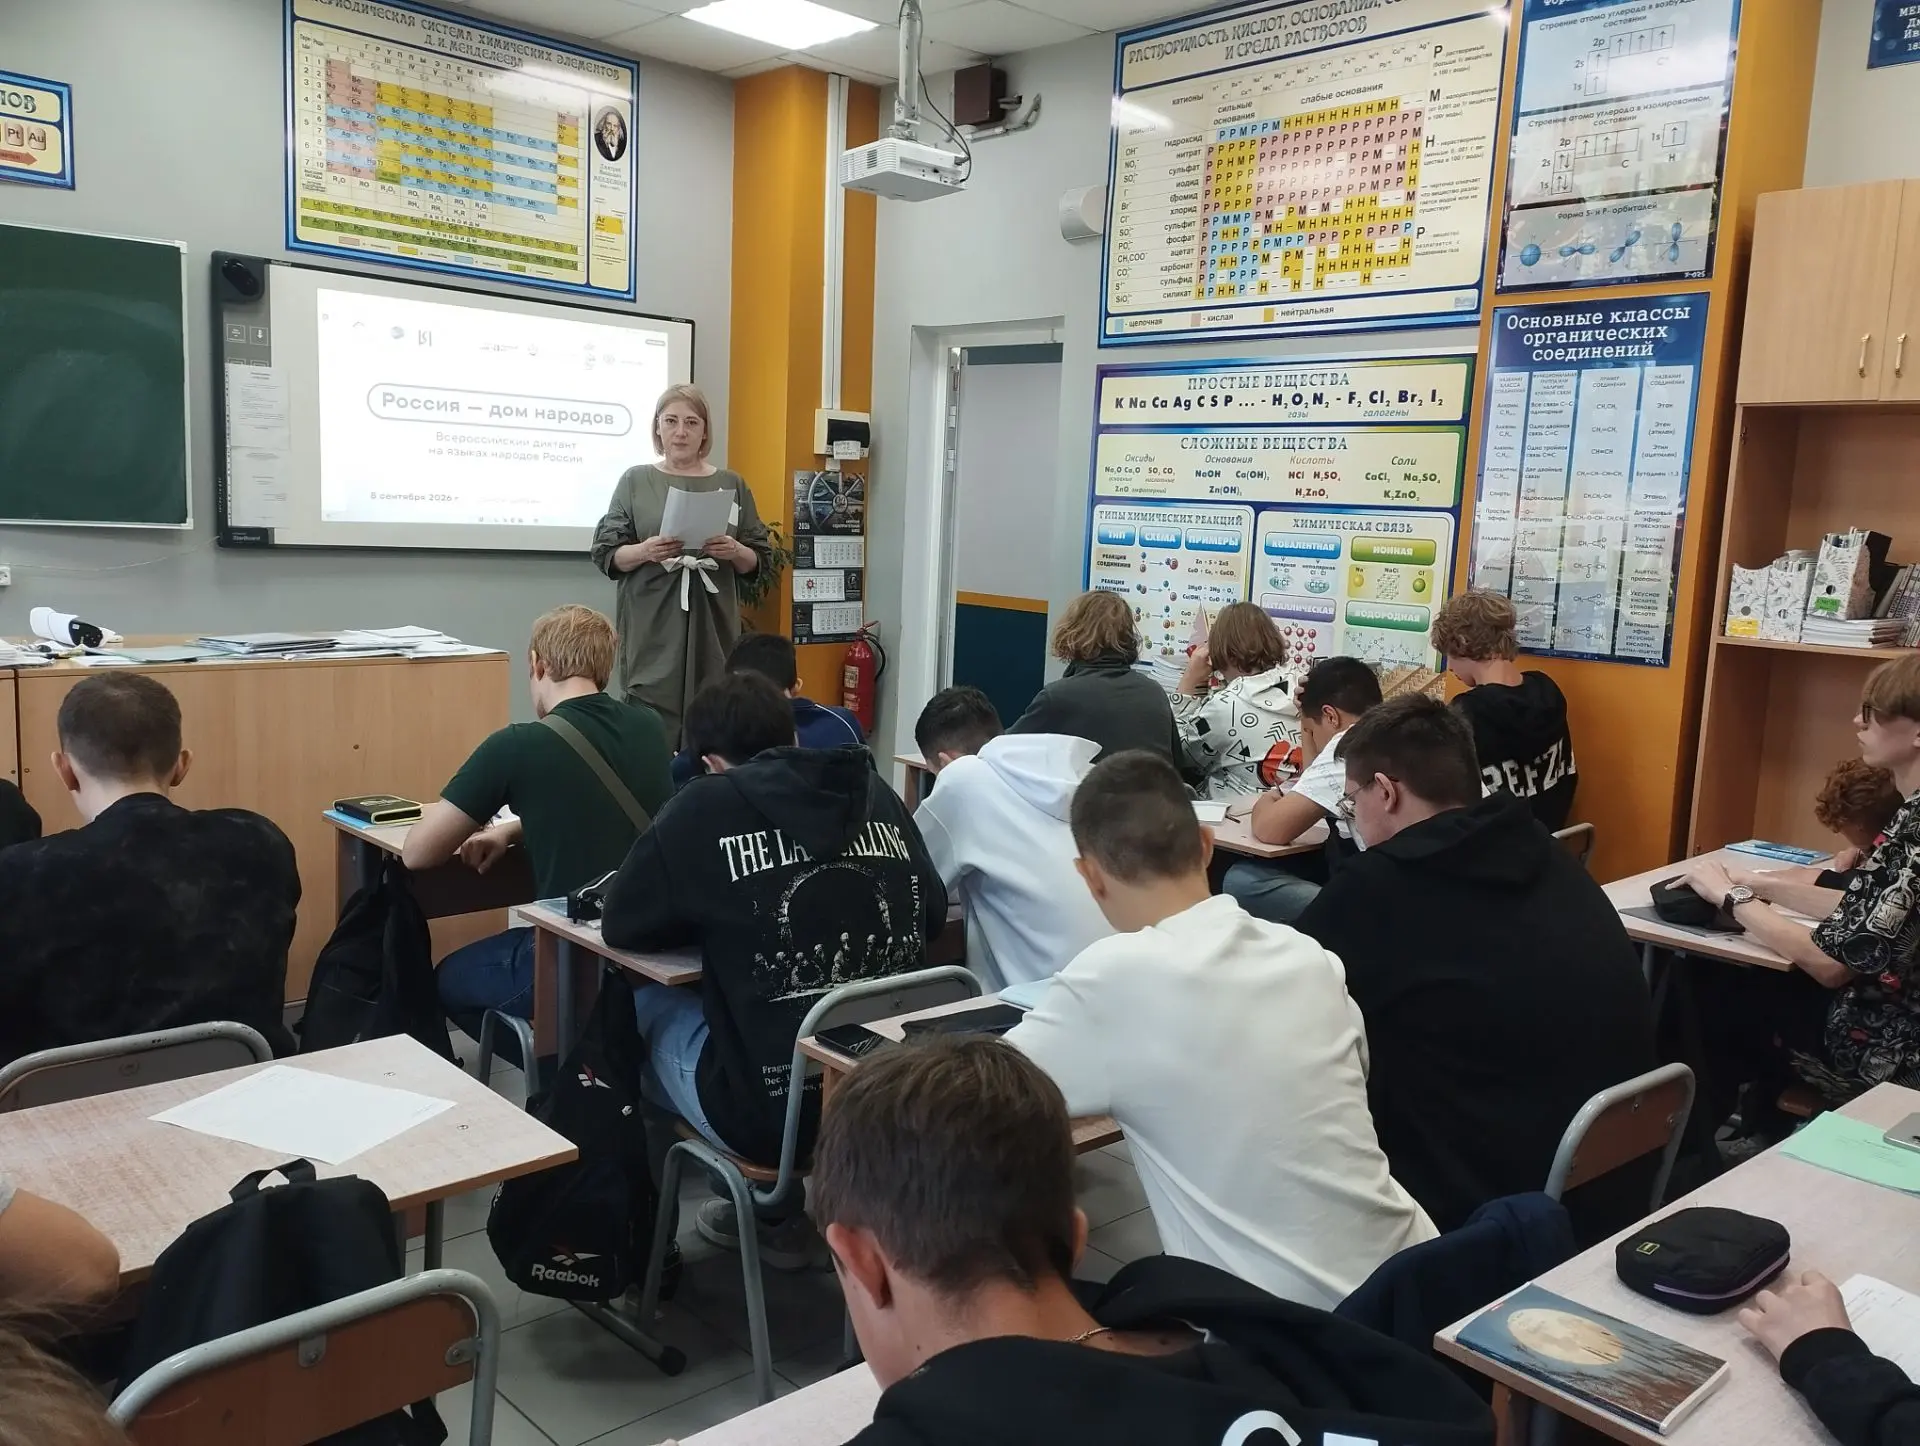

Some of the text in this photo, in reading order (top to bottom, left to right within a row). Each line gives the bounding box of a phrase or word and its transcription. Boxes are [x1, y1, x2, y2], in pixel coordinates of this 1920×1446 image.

[1539, 18, 1578, 32] Строение
[1580, 13, 1606, 24] атома
[1608, 7, 1646, 21] углерода
[1603, 15, 1647, 28] состоянии
[1128, 29, 1229, 64] РАСТВОРИМОСТЬ
[1232, 14, 1288, 41] КИСЛОТ,
[1225, 16, 1368, 60] И СРЕДА РАСТВОРОВ
[1592, 38, 1605, 47] 2p
[421, 19, 473, 41] СИСТЕМА
[478, 34, 552, 62] ХИМИЧЕСКИХ
[557, 54, 620, 81] ЭЛЕМЕНТОВ
[449, 40, 524, 69] МЕНДЕЛЕЕВА
[1575, 60, 1584, 69] 2s
[1172, 94, 1204, 105] катионы
[1300, 83, 1384, 105] слабые основания
[1217, 101, 1253, 114] сильные
[1528, 116, 1567, 128] Строение
[1569, 112, 1594, 122] атома
[1597, 105, 1635, 118] углерода
[1643, 95, 1711, 110] изолированном
[1213, 112, 1255, 126] основания
[1593, 115, 1637, 126] состоянии
[8, 127, 45, 143] Pt Au
[1165, 135, 1203, 147] гидроксид
[1560, 138, 1571, 147] 2p
[1176, 149, 1201, 159] нитрат
[1542, 159, 1551, 167] 2s
[1169, 164, 1200, 176] сульфат
[1170, 192, 1198, 203] бромид
[1170, 205, 1197, 215] хлорид
[1558, 211, 1584, 220] Форма
[1612, 203, 1657, 214] орбиталей
[1164, 221, 1196, 231] сульфит
[1166, 235, 1195, 245] фосфат
[1170, 248, 1194, 257] ацетат
[1160, 262, 1193, 272] карбонат
[1160, 276, 1193, 286] сульфид
[1162, 291, 1191, 299] силикат
[1280, 305, 1334, 318] нейтральная
[1129, 318, 1163, 328] щелочная
[1207, 313, 1234, 322] кислая
[1507, 307, 1691, 331] Основные классы
[1523, 326, 1669, 347] органических
[1532, 341, 1655, 362] соединений
[1187, 372, 1350, 391] ПРОСТЫЕ ВЕЩЕСТВА
[382, 391, 614, 426] Россия дом народов
[1115, 397, 1124, 409] K
[1129, 397, 1147, 409] Na
[1152, 396, 1168, 409] Ca
[1173, 396, 1192, 411] Ag
[1210, 395, 1218, 408] S
[1287, 411, 1309, 419] газы
[1363, 409, 1409, 418] галогены
[533, 439, 577, 450] диктант
[1180, 437, 1348, 452] СЛОЖНЫЕ ВЕЩЕСТВА
[428, 447, 583, 463] на языках народов России
[1124, 453, 1155, 463] Оксиды
[1205, 454, 1253, 464] Основания
[1289, 455, 1335, 465] Кислоты
[1391, 456, 1417, 466] Соли
[1195, 470, 1221, 478] NaOH
[1288, 471, 1304, 480] HCl
[379, 492, 425, 502] сентября
[428, 493, 452, 502] 2026
[1099, 511, 1243, 526] ТИПЫ ХИМИЧЕСКИХ РЕАКЦИЙ
[1292, 518, 1413, 533] ХИМИЧЕСКАЯ СВЯЗЬ
[1108, 530, 1126, 540] ТИП
[1145, 532, 1176, 543] СХЕМА
[1188, 535, 1239, 546] ПРИМЕРЫ
[1271, 540, 1336, 552] КОВАЛЕНТНАЯ
[1372, 545, 1413, 556] ИОННАЯ
[719, 831, 774, 883] THE
[910, 875, 921, 918] RUINS
[762, 1063, 792, 1075] Fragm
[531, 1263, 600, 1288] Reebok
